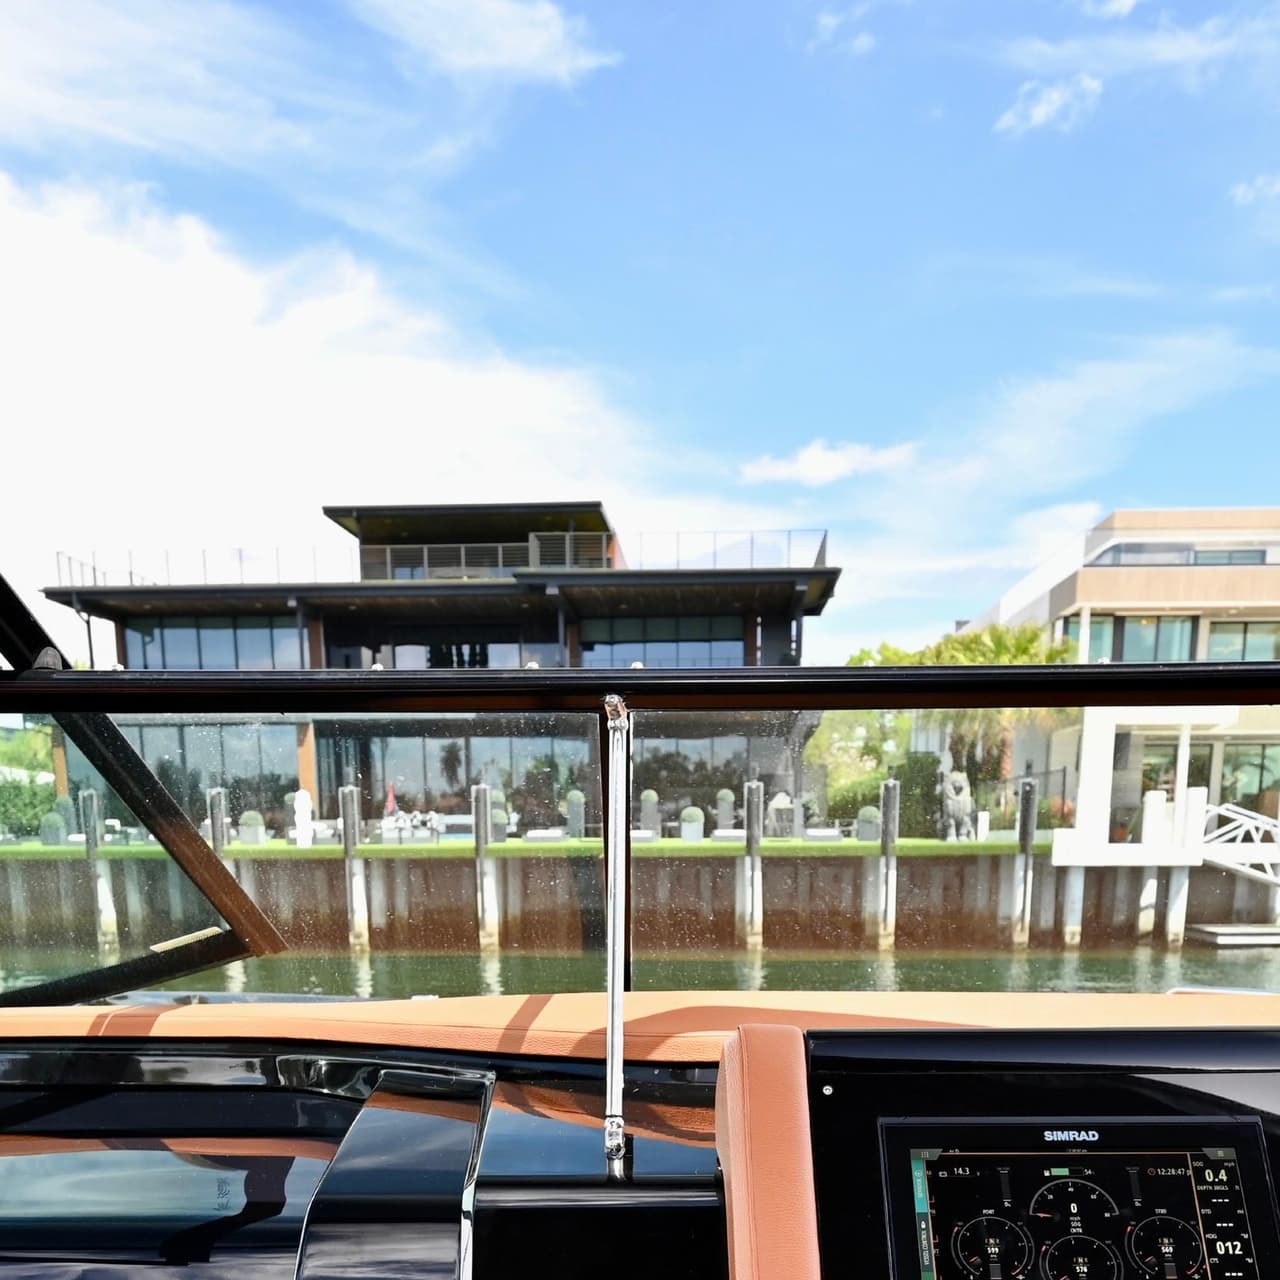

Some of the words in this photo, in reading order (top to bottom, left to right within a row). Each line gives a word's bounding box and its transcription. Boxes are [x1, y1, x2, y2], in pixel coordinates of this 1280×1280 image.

[1043, 1130, 1099, 1141] SIMRAD
[953, 1167, 970, 1175] 14.3
[1157, 1168, 1186, 1176] 12:28:47
[1204, 1168, 1228, 1182] 0.4
[1070, 1202, 1078, 1213] 0
[1215, 1241, 1243, 1255] 012
